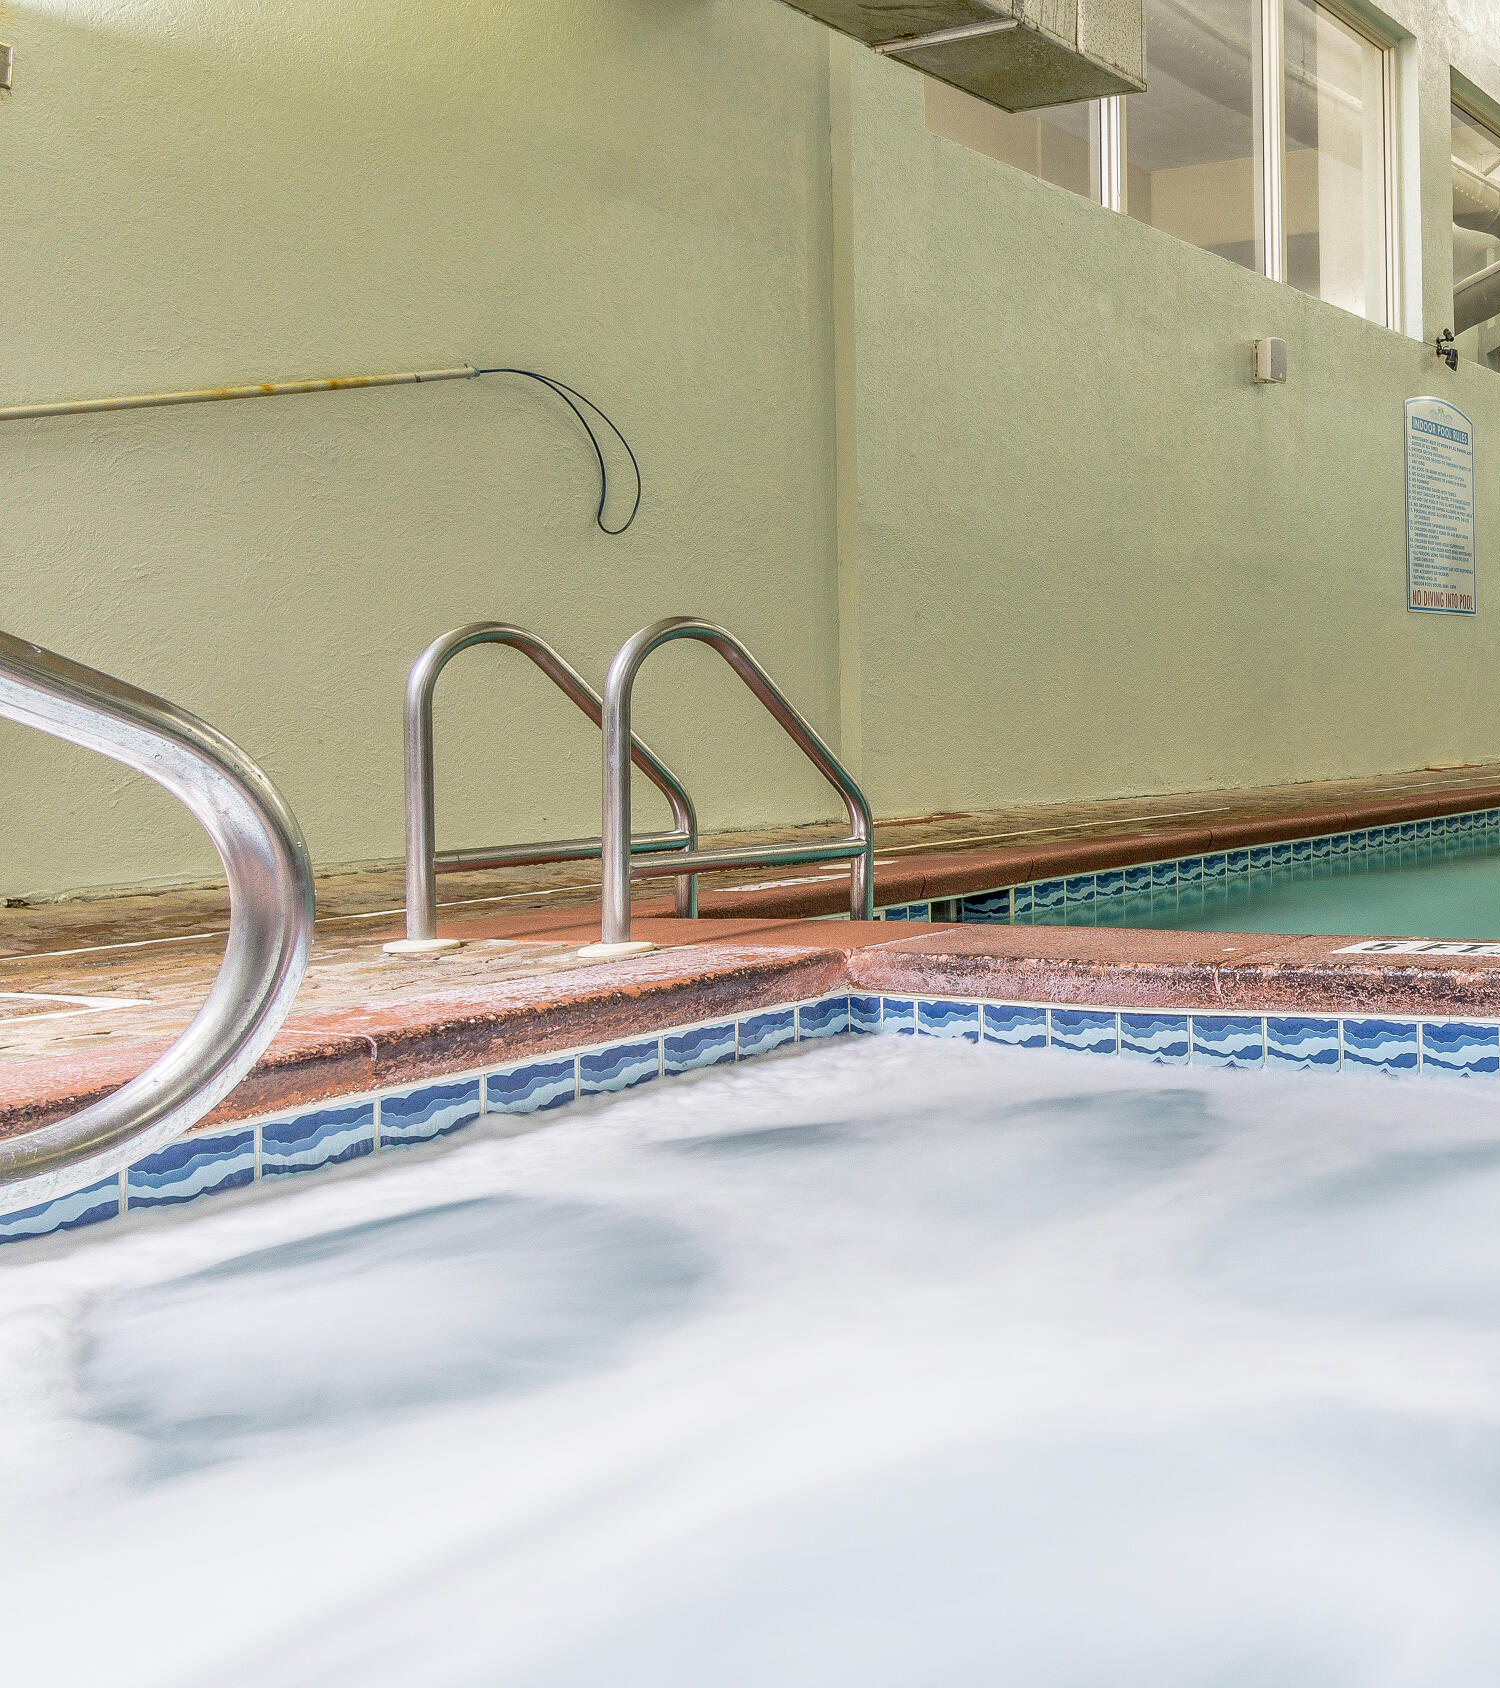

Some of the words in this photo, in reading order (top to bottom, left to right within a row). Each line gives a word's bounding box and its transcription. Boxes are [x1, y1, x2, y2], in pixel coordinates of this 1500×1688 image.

[1414, 418, 1435, 434] INDOOR
[1437, 425, 1451, 438] POOL
[1452, 430, 1467, 443] RULES
[1412, 590, 1422, 605] NO
[1424, 591, 1444, 607] DIVING
[1446, 593, 1458, 608] INTO
[1460, 594, 1474, 610] POOL
[1361, 942, 1408, 950] 5
